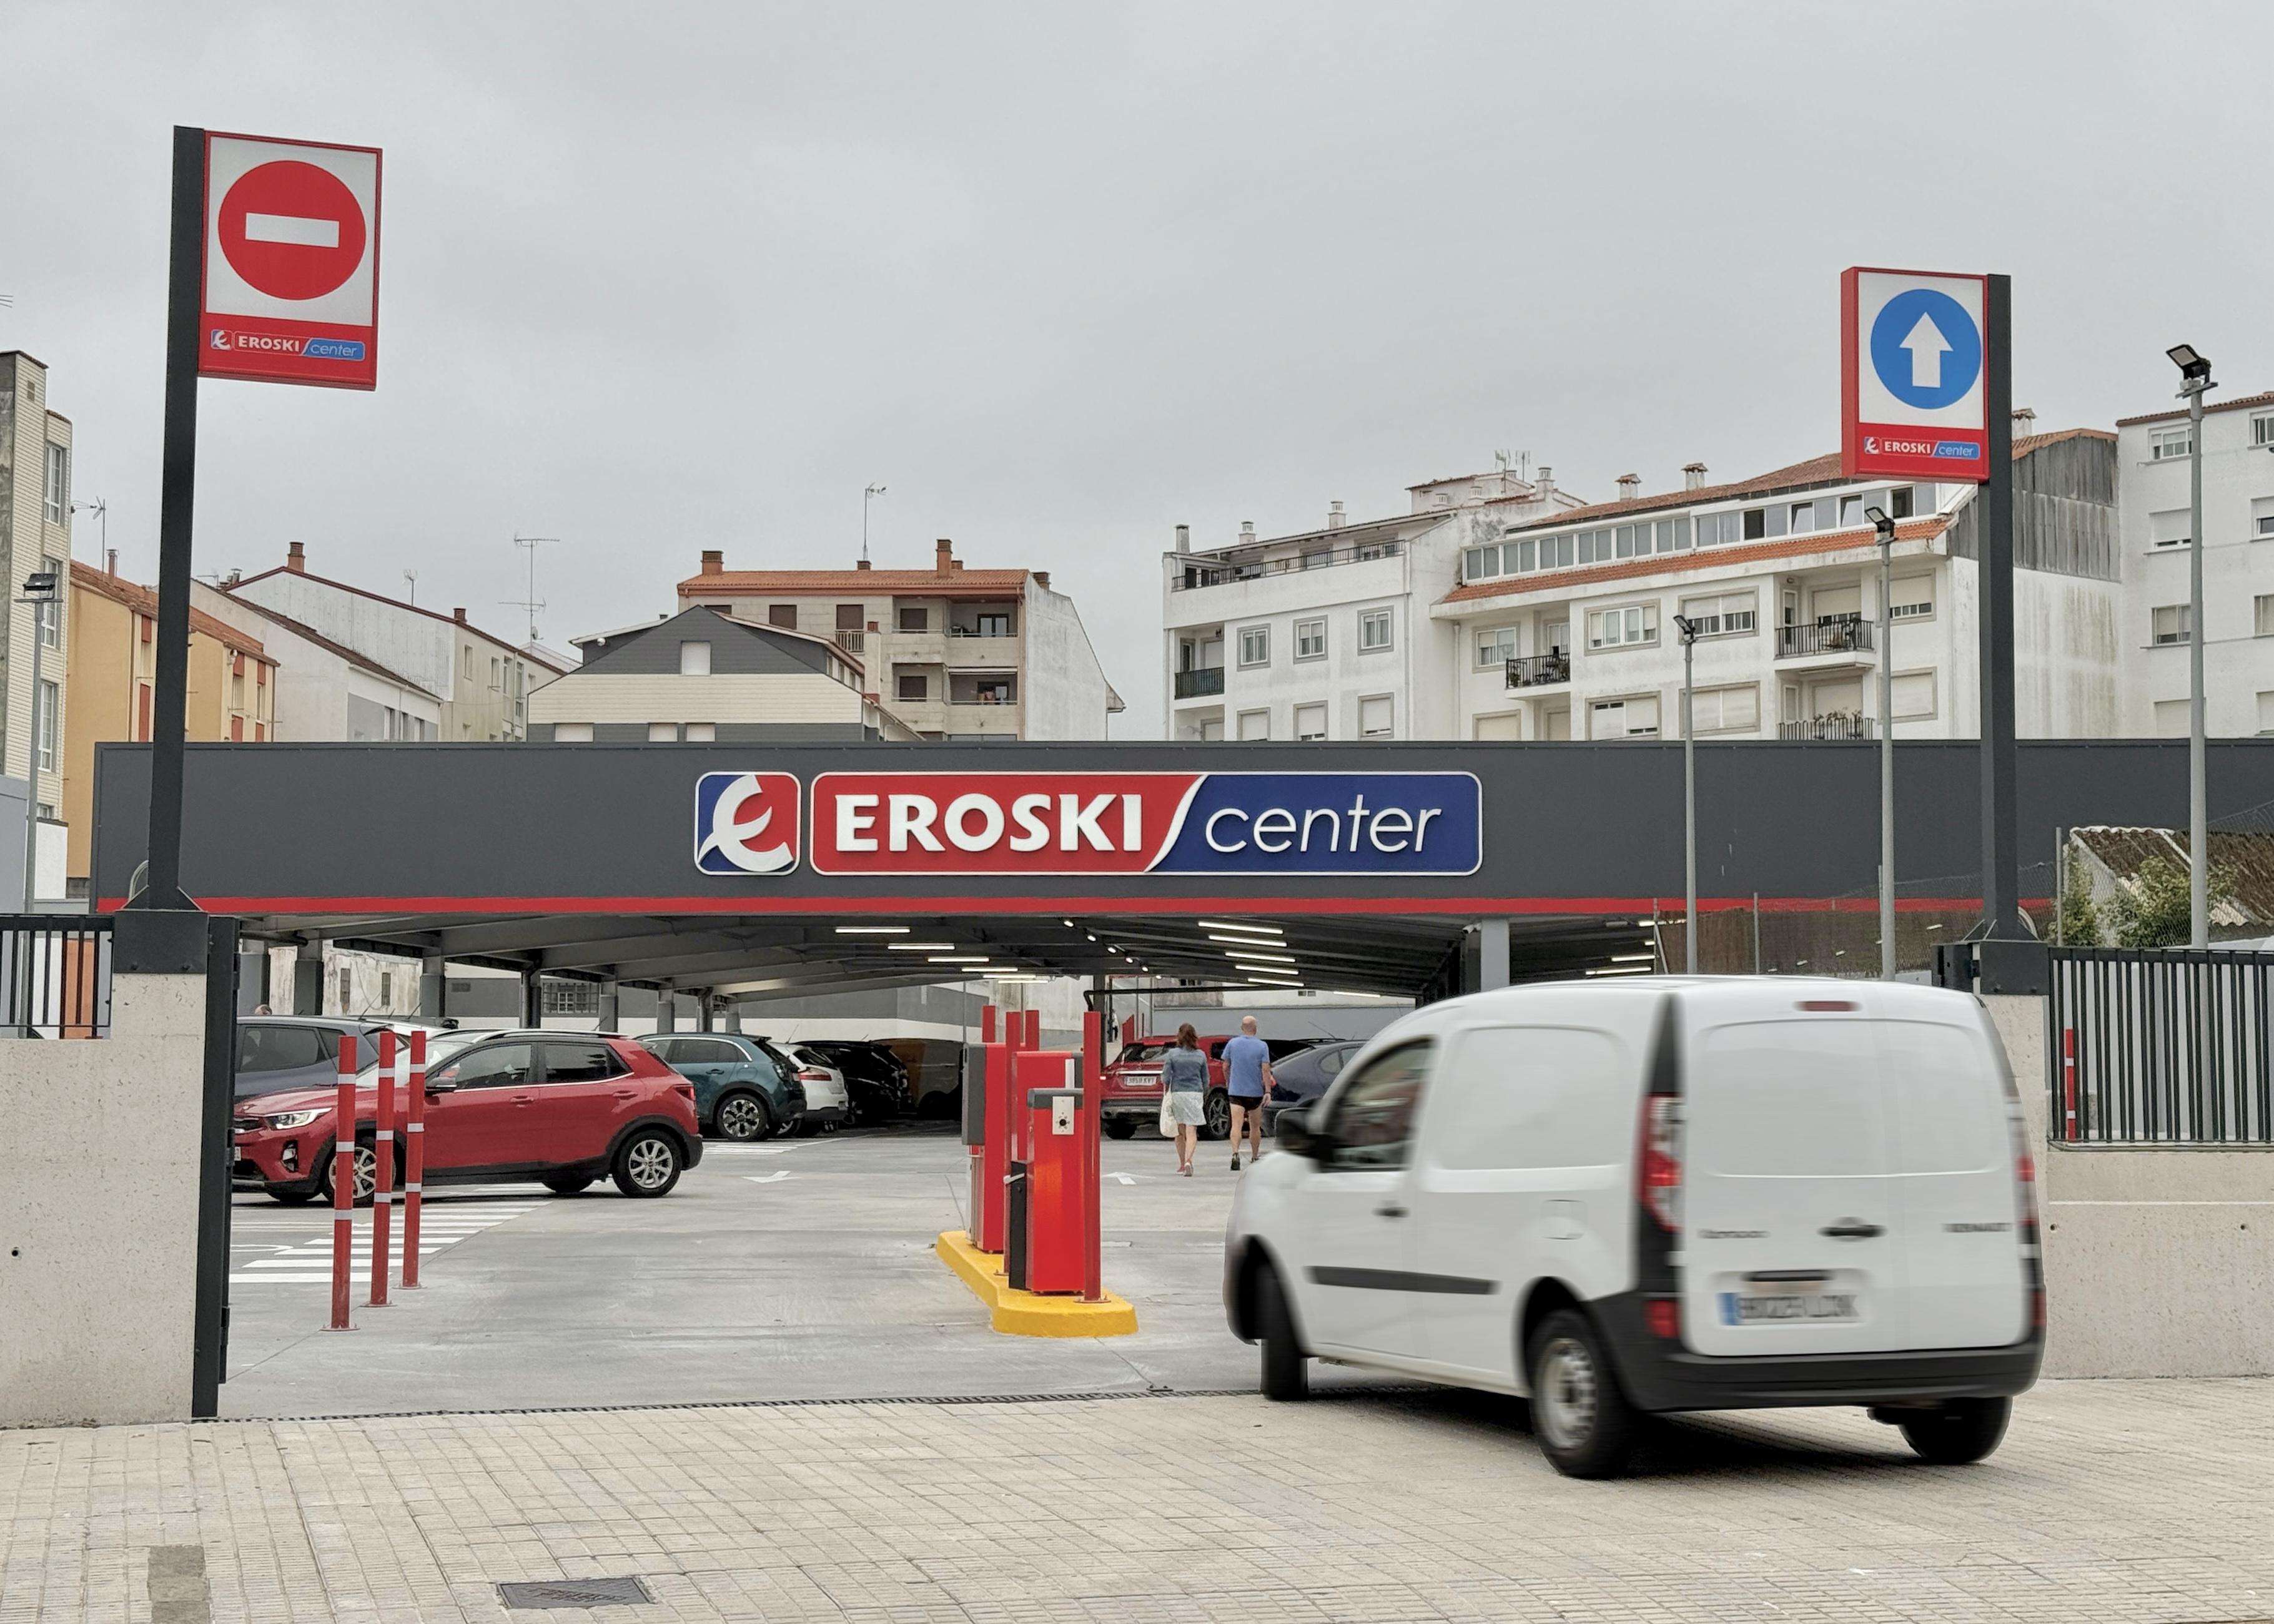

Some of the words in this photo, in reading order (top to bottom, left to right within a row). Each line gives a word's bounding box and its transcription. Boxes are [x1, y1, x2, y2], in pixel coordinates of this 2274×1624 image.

[238, 335, 300, 352] EROSKI
[310, 343, 357, 357] center
[1884, 441, 1931, 454] EROSKI
[1938, 446, 1974, 456] center
[835, 793, 1142, 852] EROSKI
[1205, 794, 1442, 853] center
